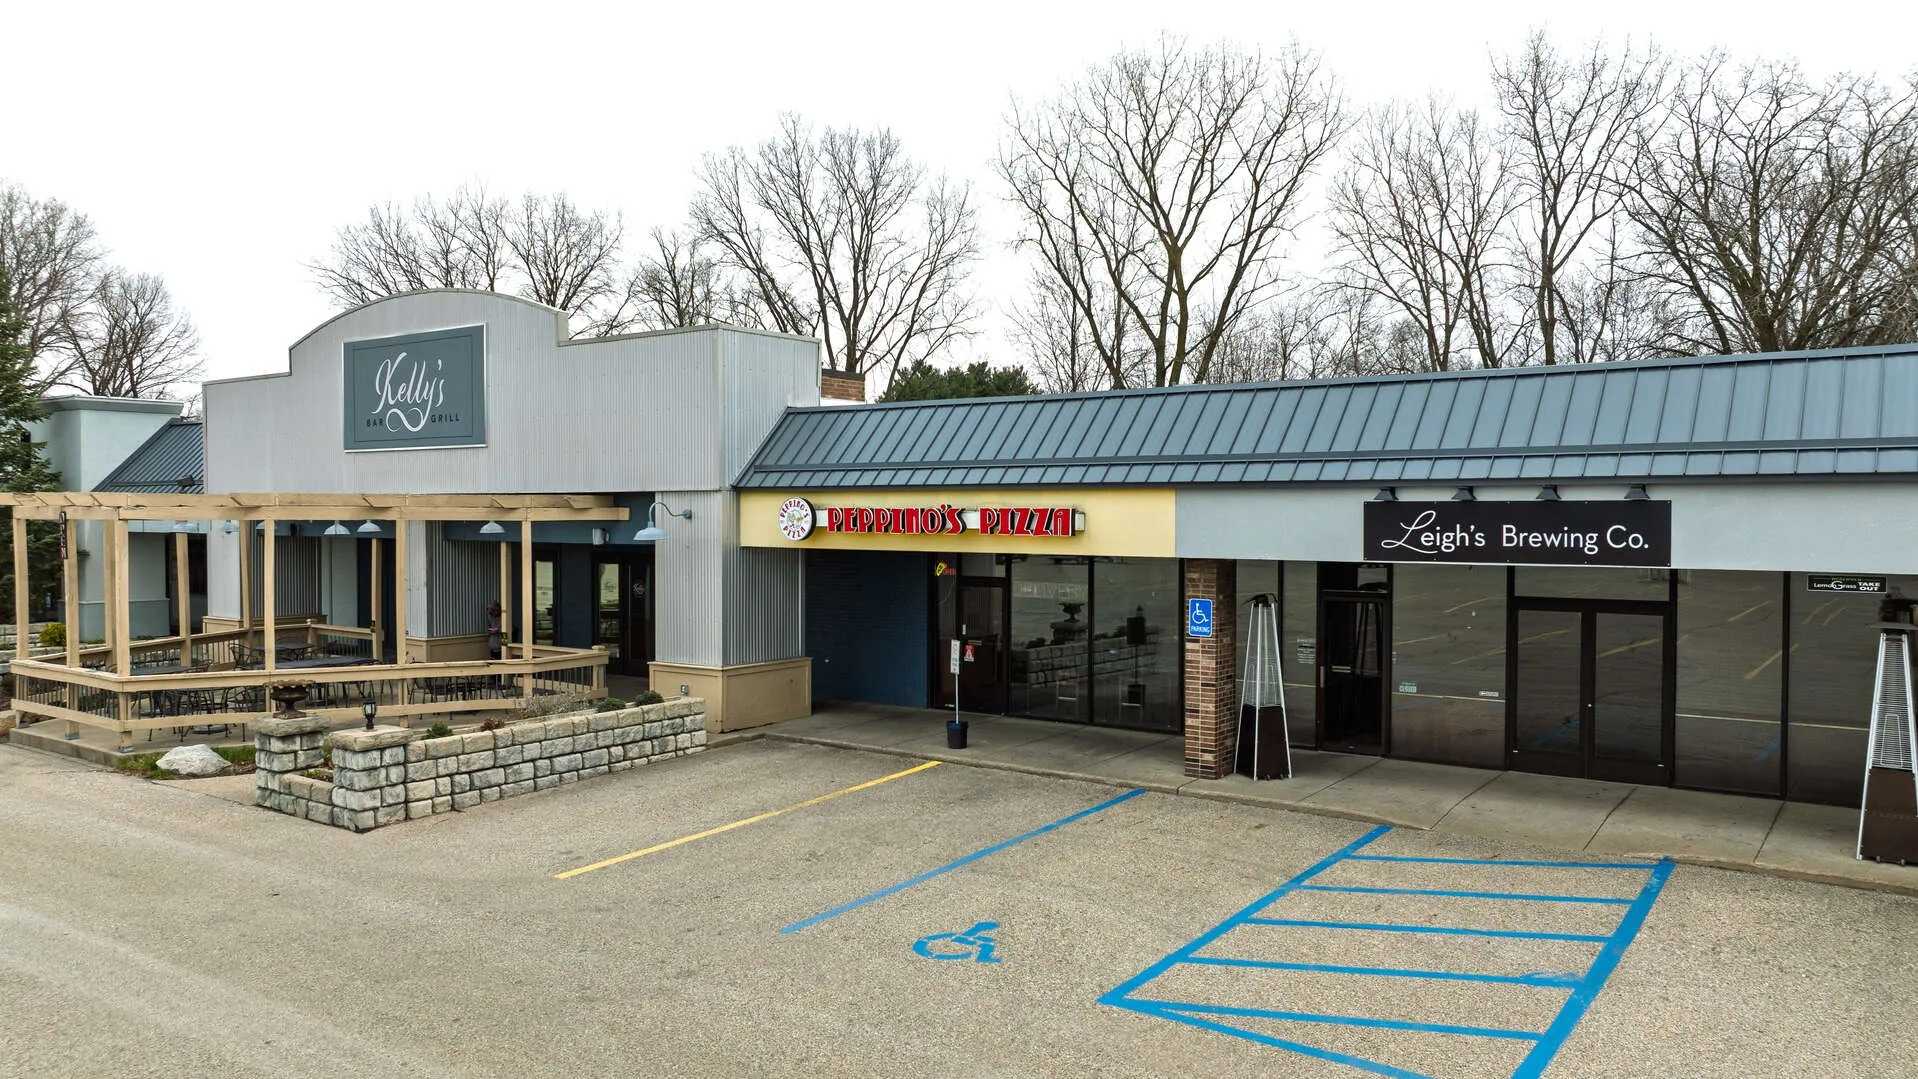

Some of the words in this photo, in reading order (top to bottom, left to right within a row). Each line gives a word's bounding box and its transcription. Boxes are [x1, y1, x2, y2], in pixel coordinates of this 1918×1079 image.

[371, 352, 445, 432] Kelly's
[430, 412, 460, 423] GRILL
[826, 504, 963, 535] PEPPINO'S
[978, 507, 1073, 537] PIZZA
[1381, 510, 1486, 554] Leigh's
[1502, 525, 1599, 555] Brewing
[1606, 525, 1650, 549] Co.
